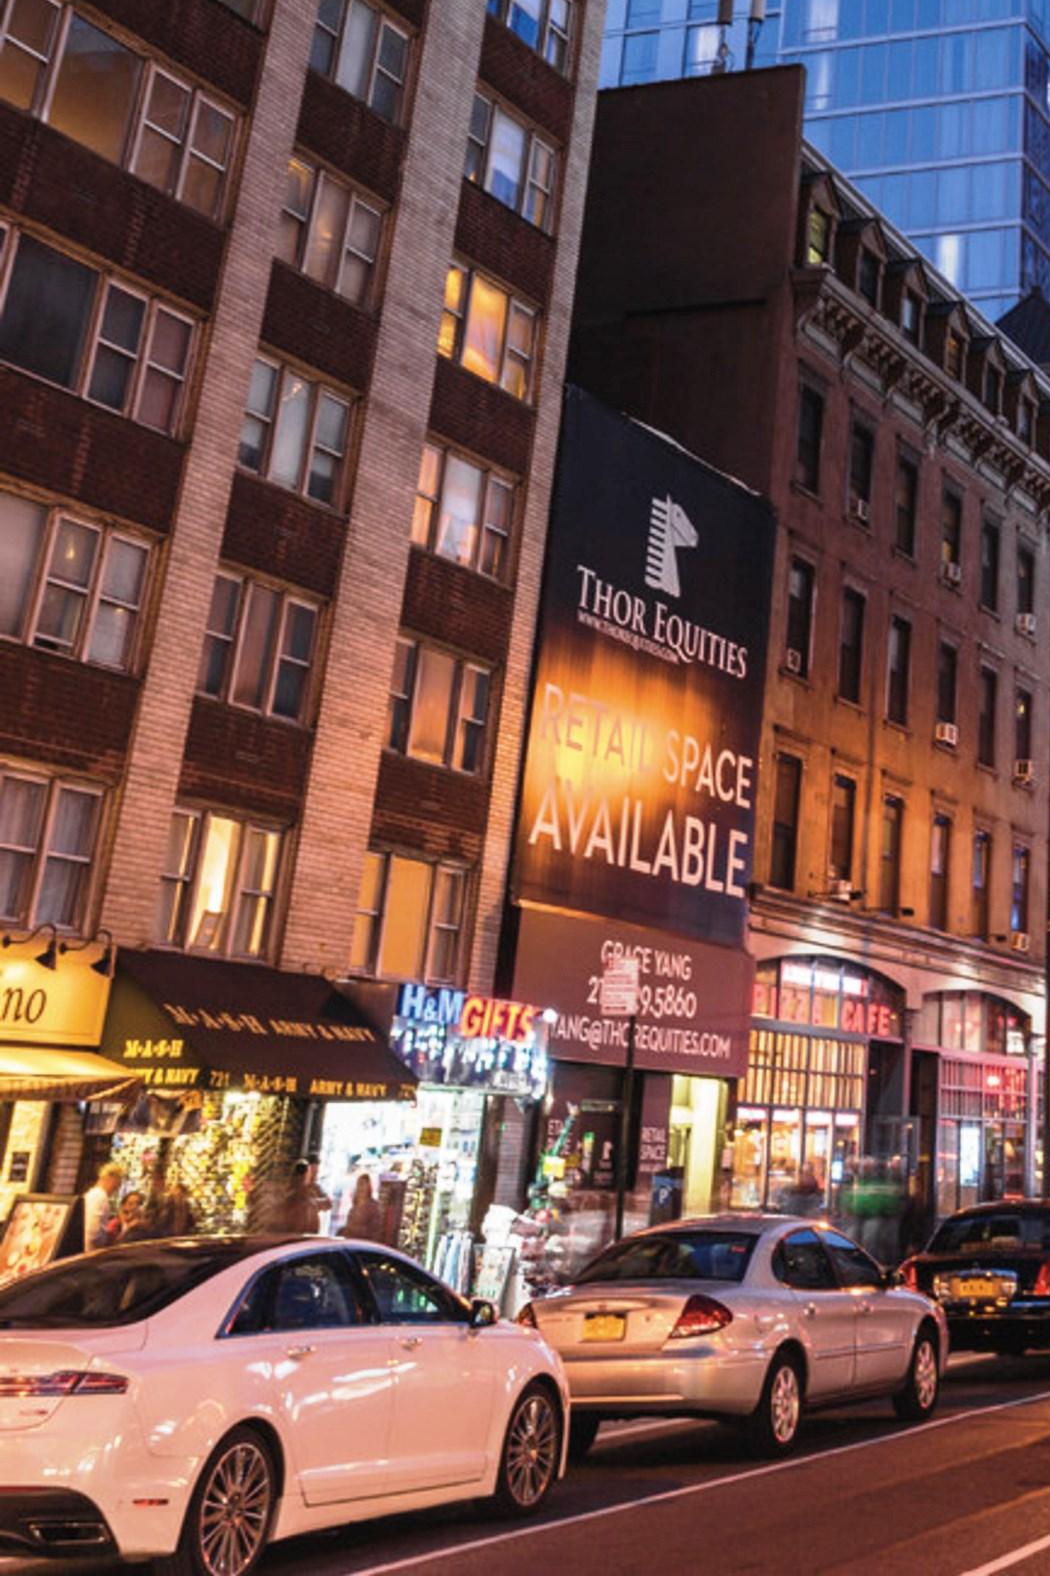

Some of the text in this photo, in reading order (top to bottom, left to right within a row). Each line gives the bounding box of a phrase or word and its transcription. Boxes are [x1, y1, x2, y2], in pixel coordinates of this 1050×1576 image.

[577, 565, 748, 679] THOR EQUITIES
[540, 682, 752, 809] RETAIL SPACE
[529, 774, 749, 899] AVAILABLE
[460, 996, 535, 1043] GIFTS
[654, 949, 692, 981] YANG
